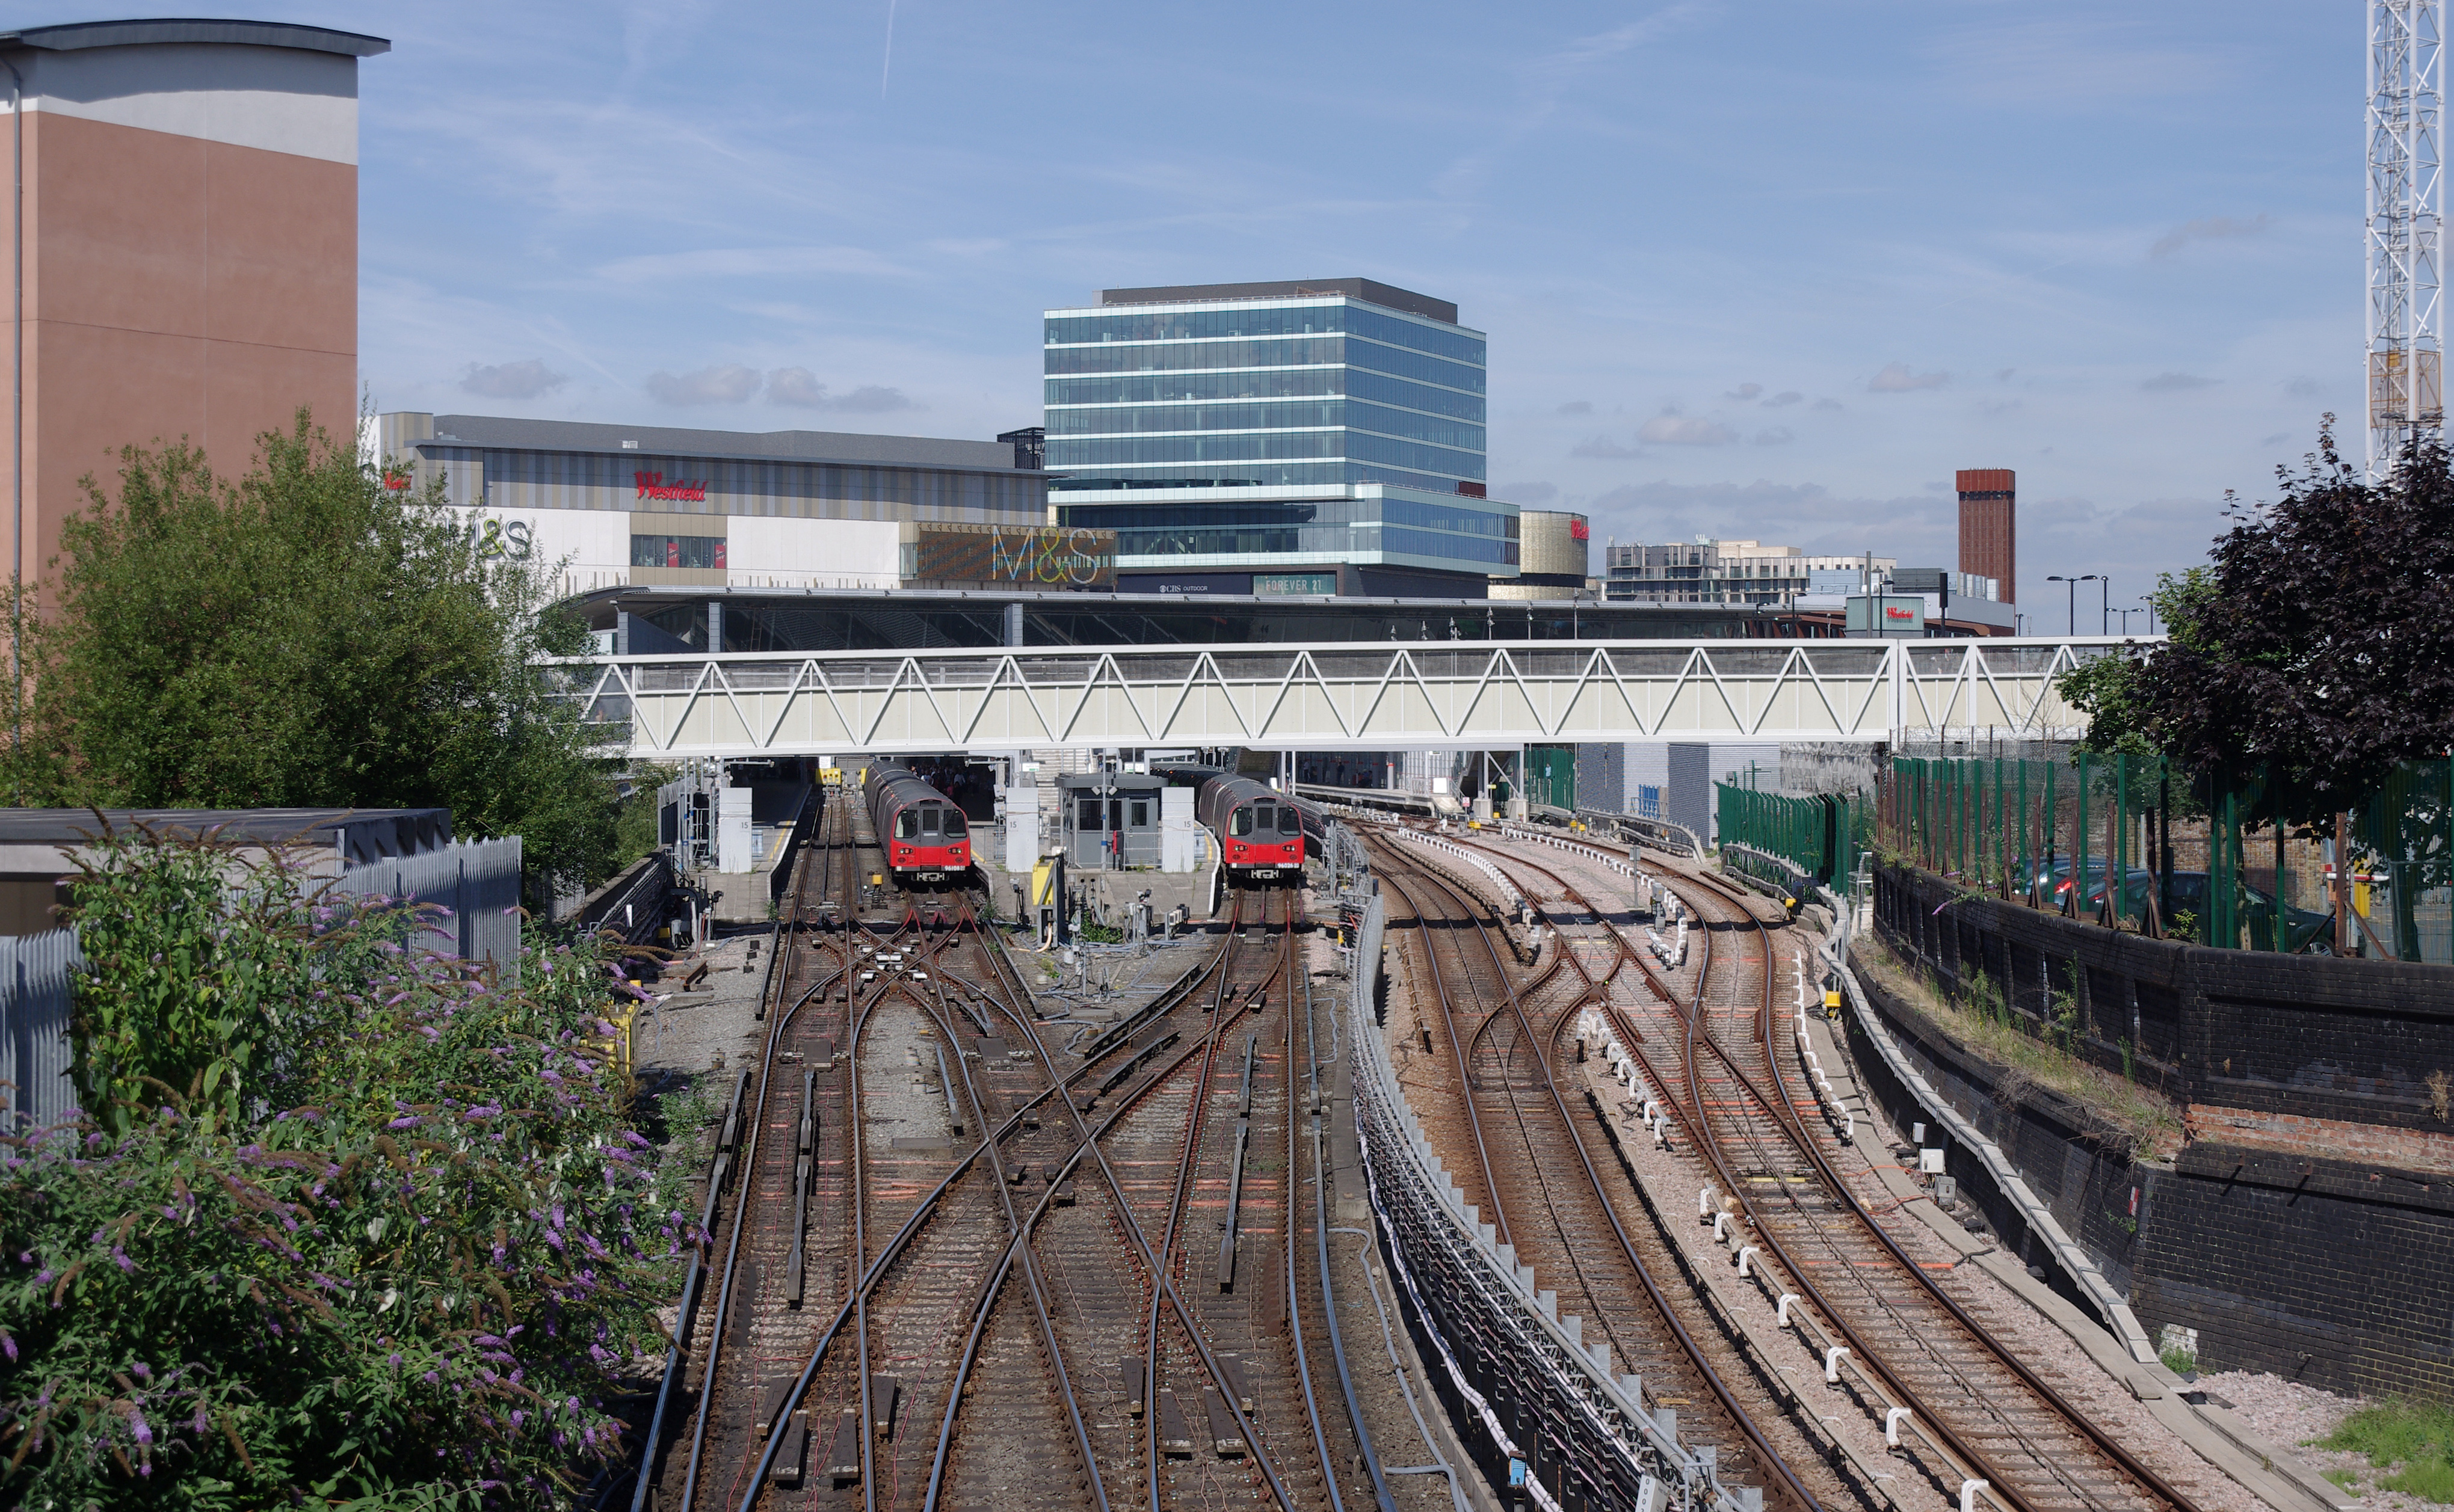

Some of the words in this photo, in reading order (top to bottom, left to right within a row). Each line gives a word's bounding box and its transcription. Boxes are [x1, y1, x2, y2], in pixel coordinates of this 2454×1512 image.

[634, 470, 708, 501] Westfield
[993, 525, 1097, 584] M&S
[1266, 580, 1307, 591] FOREVER
[1312, 579, 1321, 591] 21
[1887, 607, 1914, 618] Westfield
